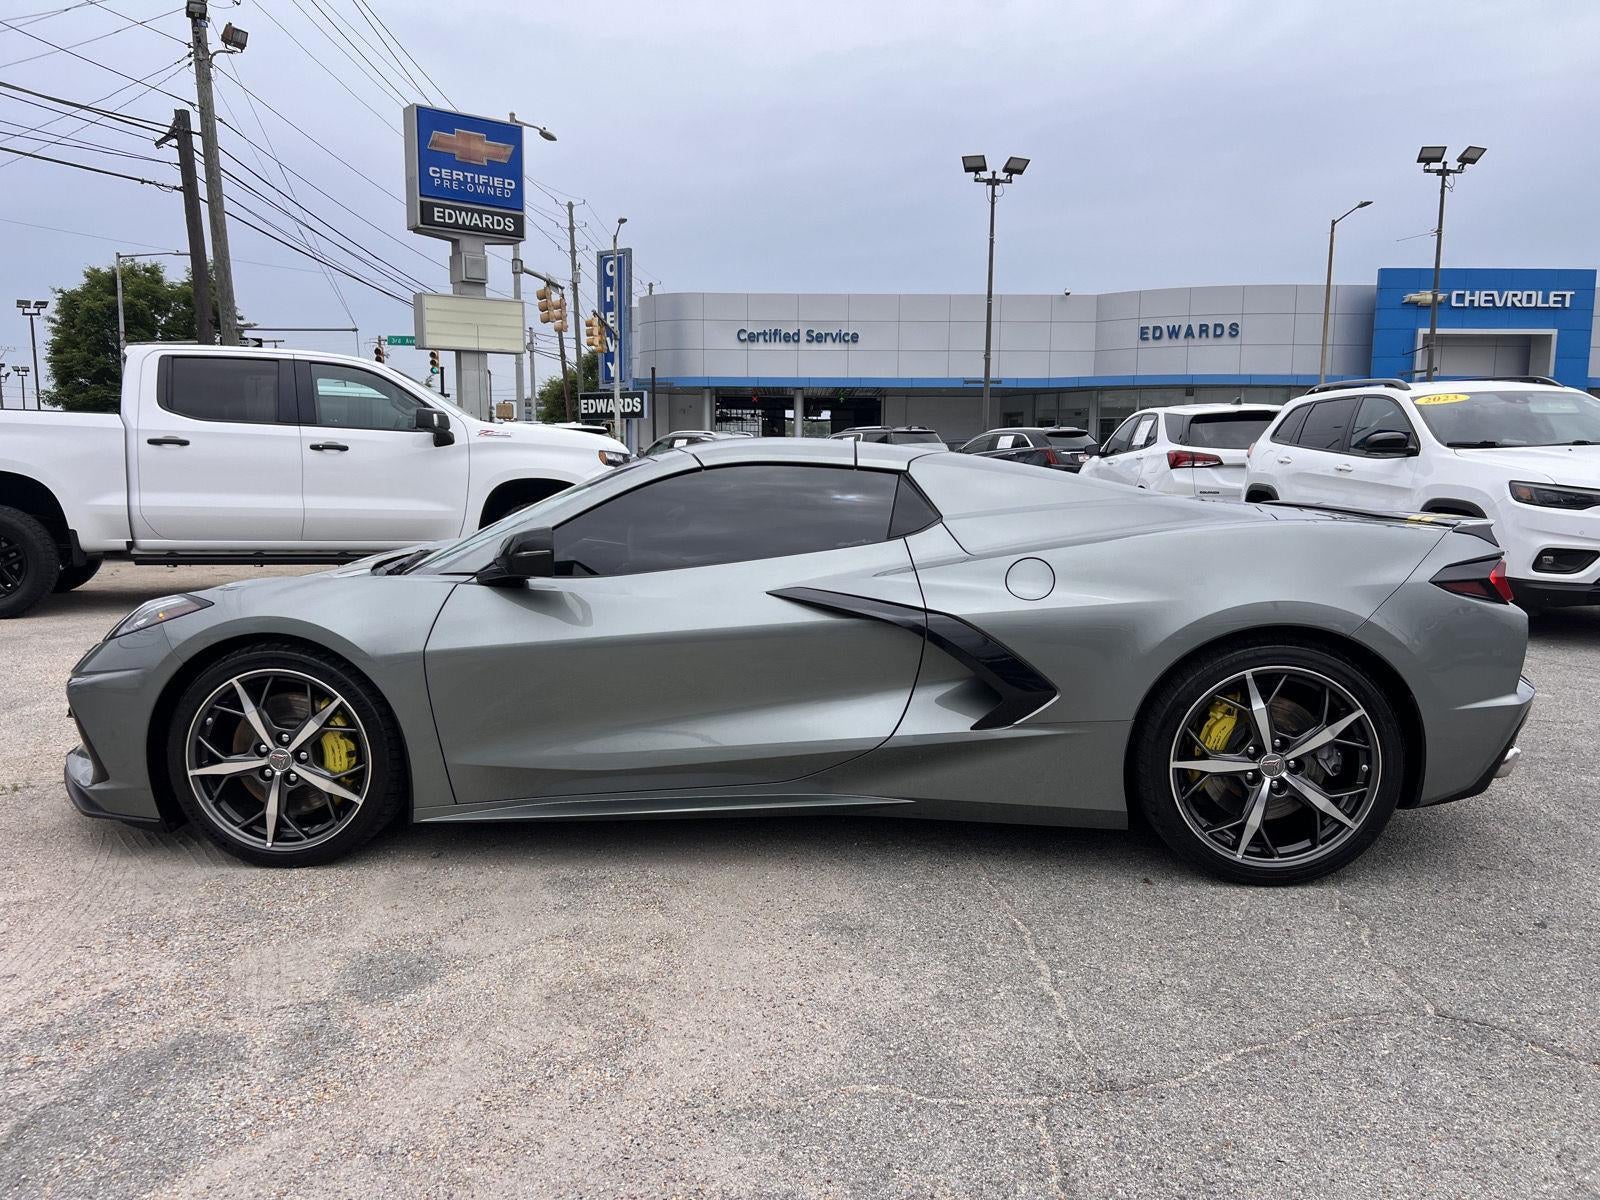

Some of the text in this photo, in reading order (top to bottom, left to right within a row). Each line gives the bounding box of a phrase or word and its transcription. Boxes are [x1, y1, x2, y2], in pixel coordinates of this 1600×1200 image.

[428, 166, 516, 190] CERTIFIED
[434, 178, 512, 198] PRE-OWNED
[433, 207, 515, 232] EDWARDS
[1451, 290, 1576, 308] CHEVROLET
[736, 328, 860, 343] Certified Service
[1140, 322, 1240, 341] EDWARDS
[580, 397, 641, 414] EDWARDS
